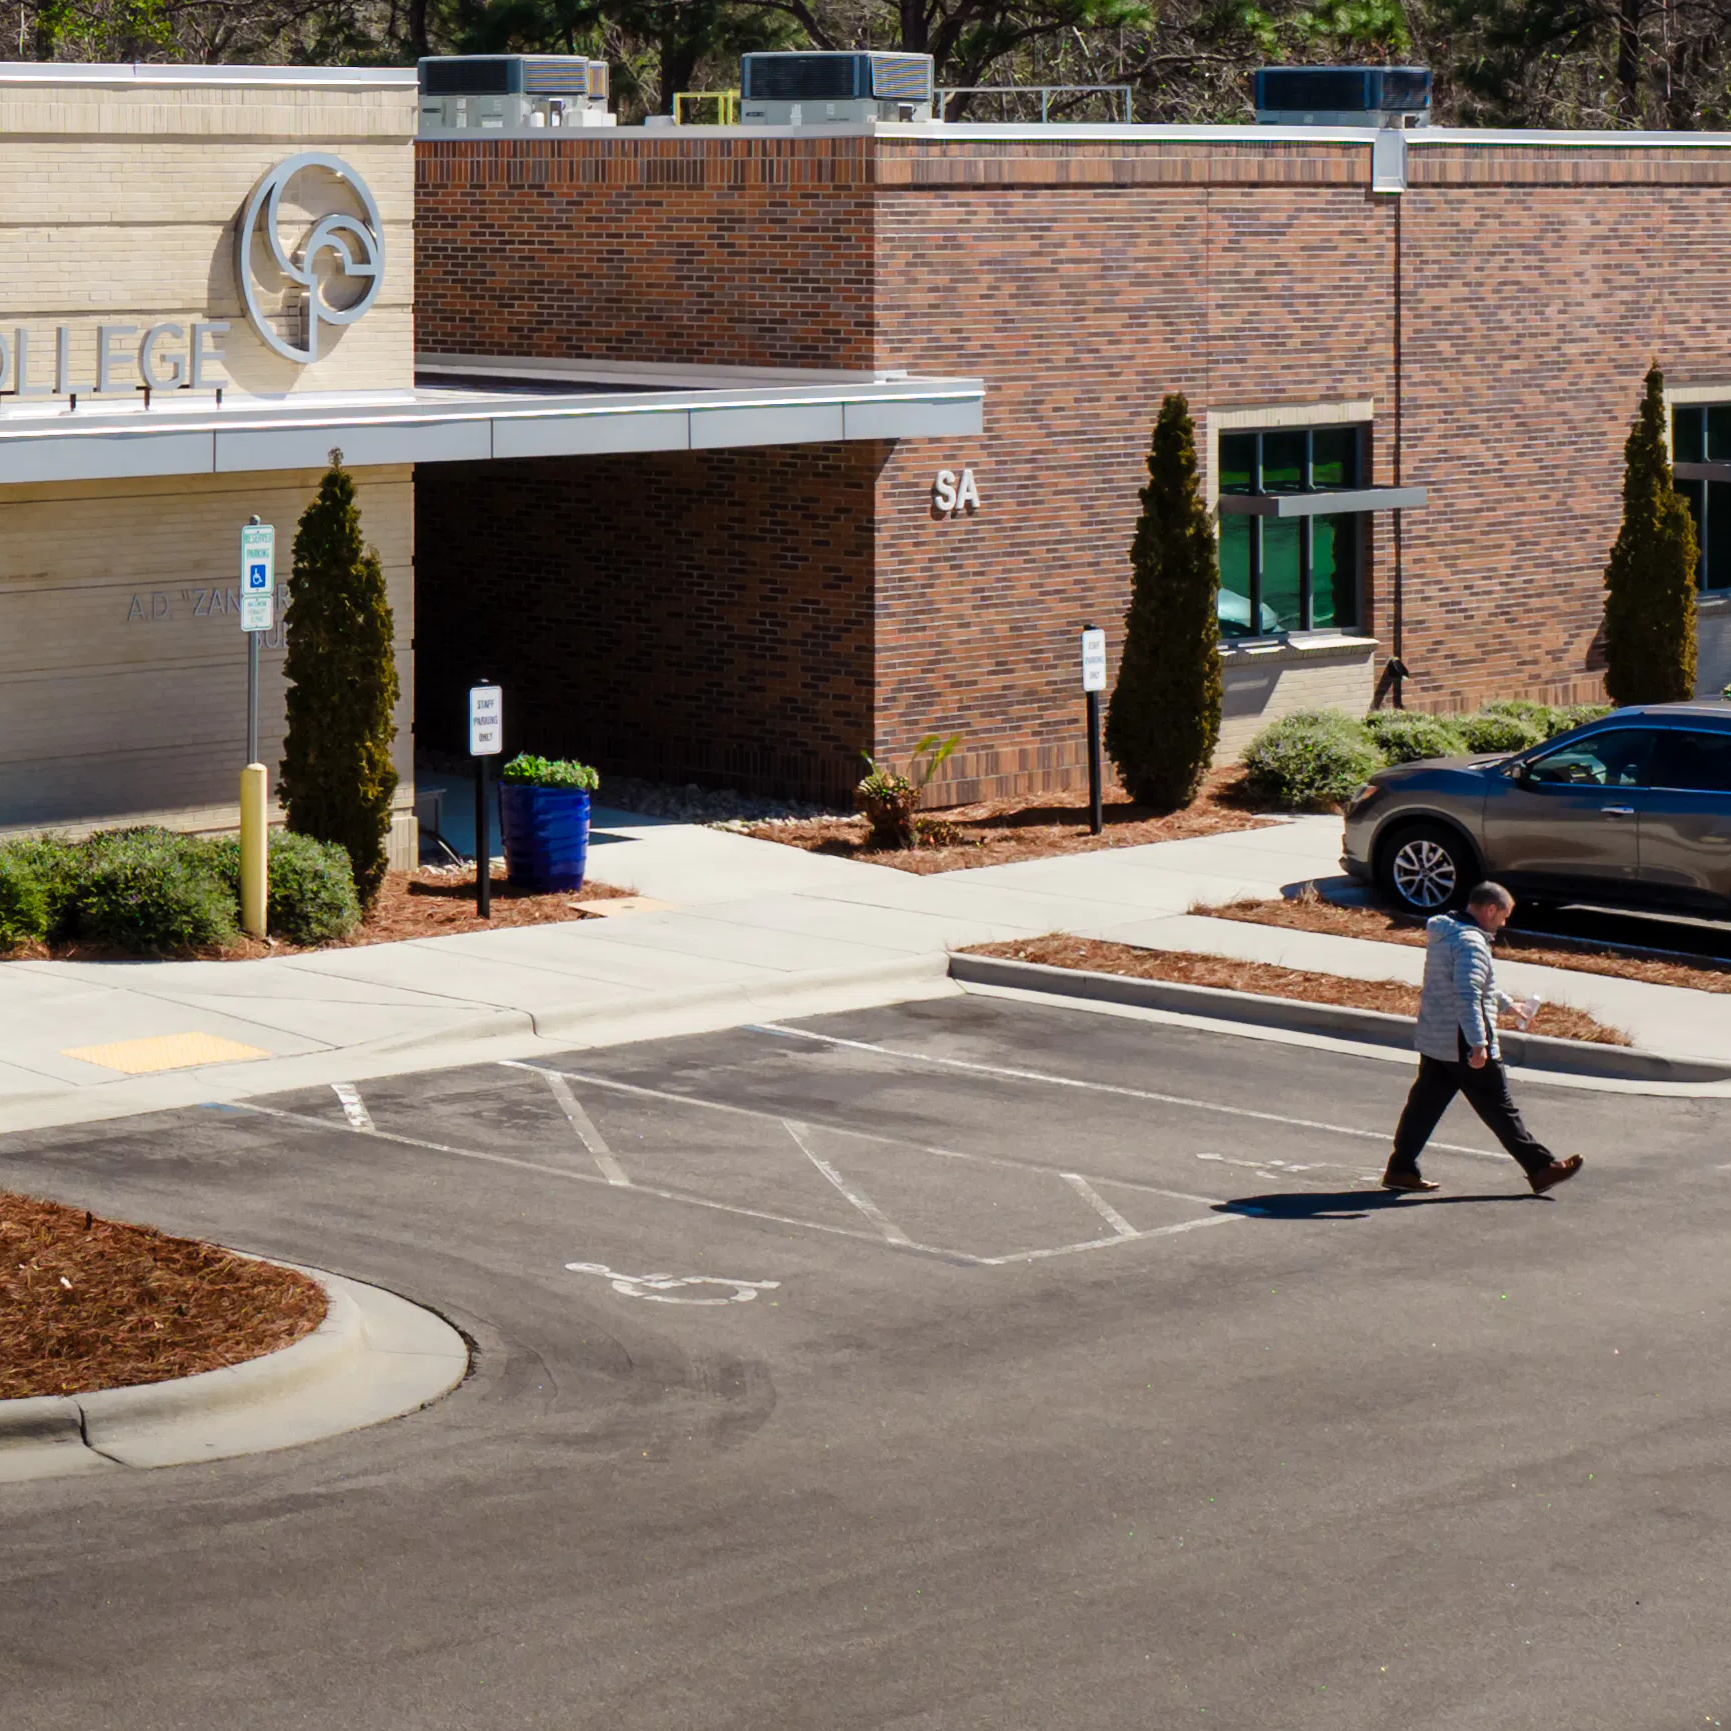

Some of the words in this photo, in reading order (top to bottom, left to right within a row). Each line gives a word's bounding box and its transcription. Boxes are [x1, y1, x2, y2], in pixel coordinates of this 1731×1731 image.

[935, 468, 980, 511] SA
[246, 548, 270, 559] PARKING
[477, 699, 494, 709] STAFF
[473, 715, 498, 726] PARKING
